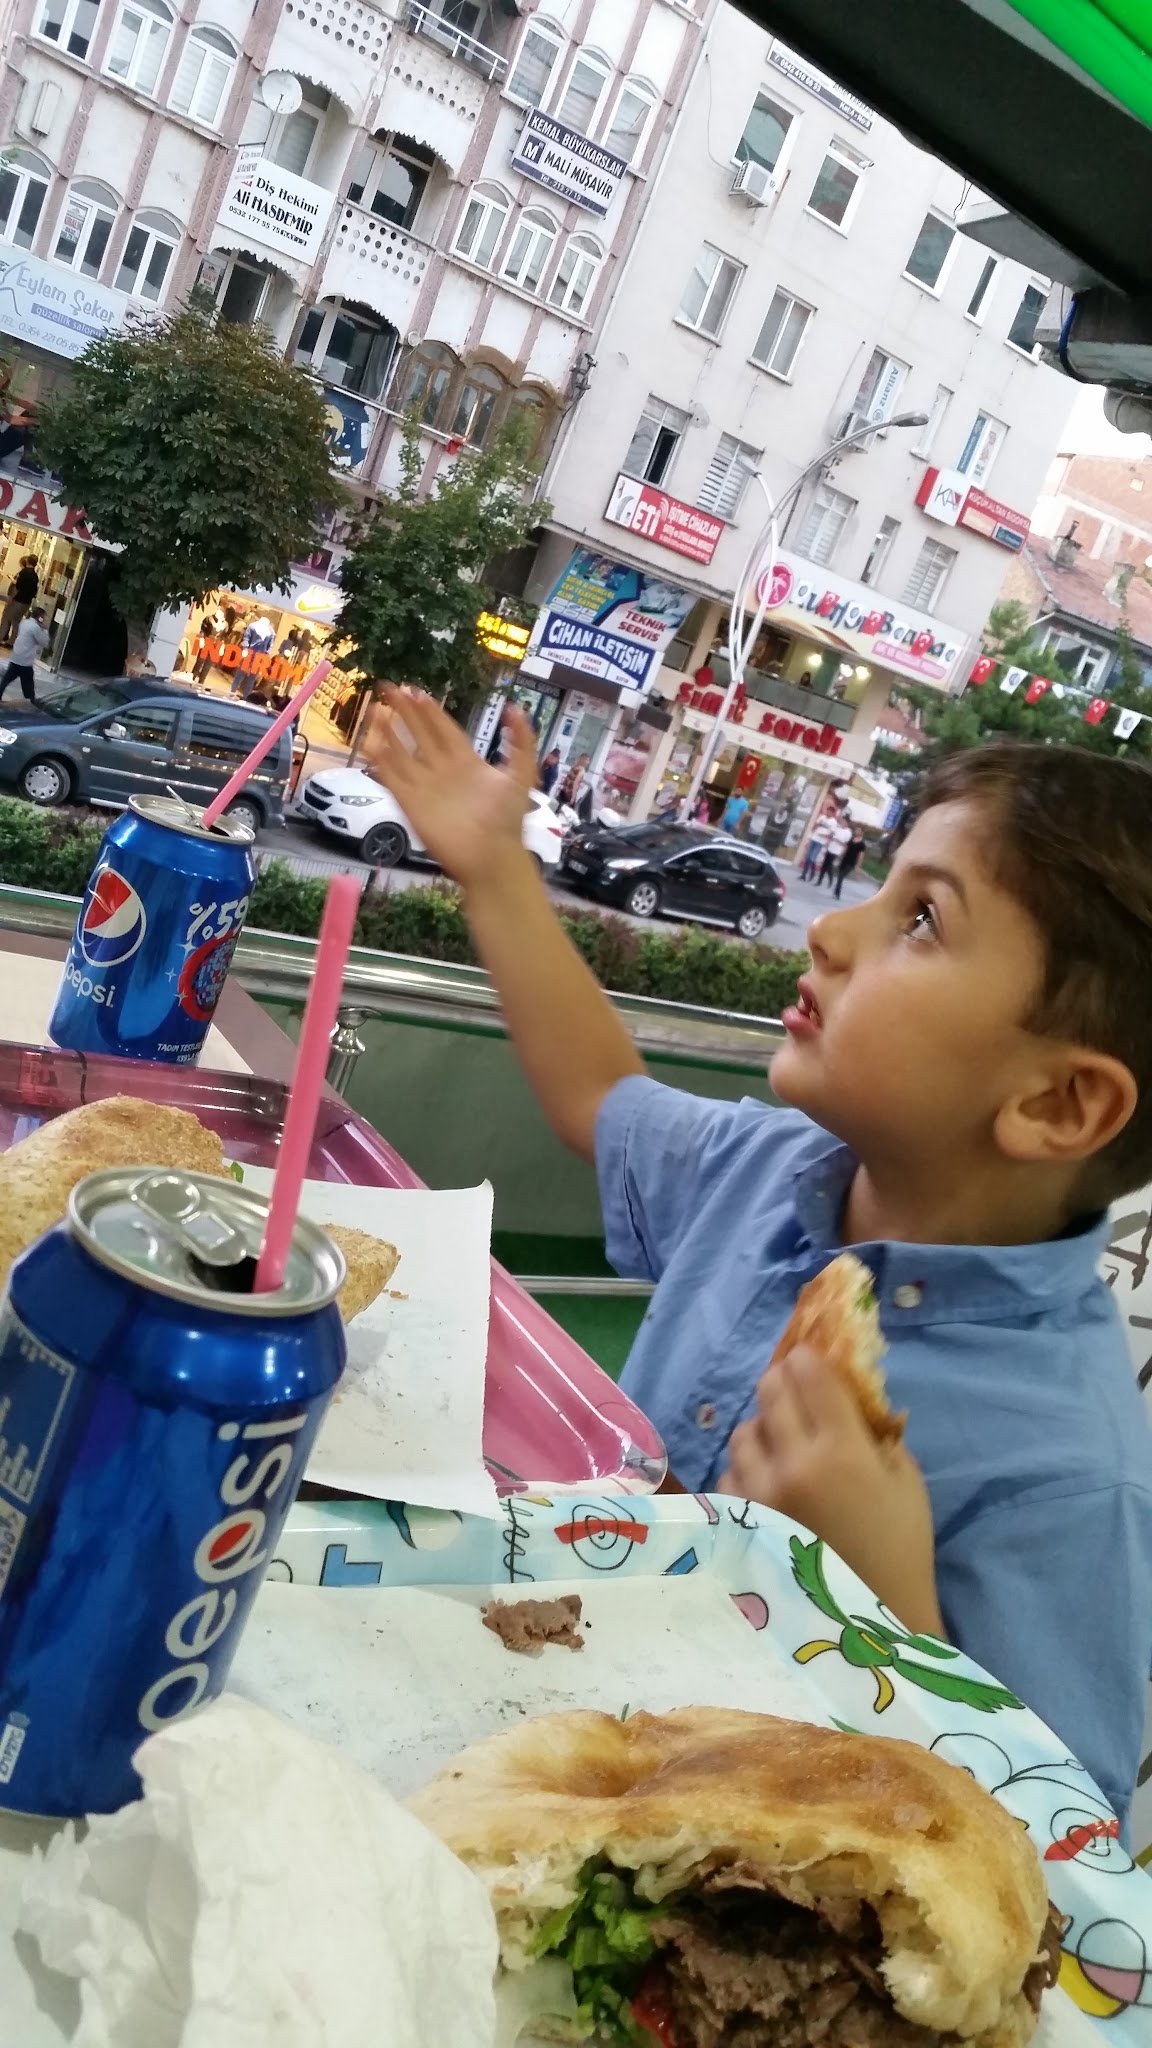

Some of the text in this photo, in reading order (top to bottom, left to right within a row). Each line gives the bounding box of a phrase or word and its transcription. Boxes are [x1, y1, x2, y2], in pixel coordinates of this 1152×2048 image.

[531, 115, 623, 177] KEMAL BÜYÜKARSLAN
[256, 177, 319, 216] Diş Hekimi
[544, 150, 613, 199] MALİ MÜŞAVİR
[228, 205, 247, 218] 0532
[248, 214, 261, 225] 177
[262, 220, 271, 229] 55
[232, 188, 313, 236] Ali HASDEMİR
[16, 265, 115, 323] Eylem Şeker
[617, 621, 661, 642] SERVİS
[625, 610, 668, 632] TEKNİK
[548, 618, 594, 648] CİHAN
[593, 634, 650, 675] İLETİŞİM
[186, 896, 249, 941] %59
[64, 962, 114, 1008] pepsi
[157, 1043, 180, 1052] TADIM
